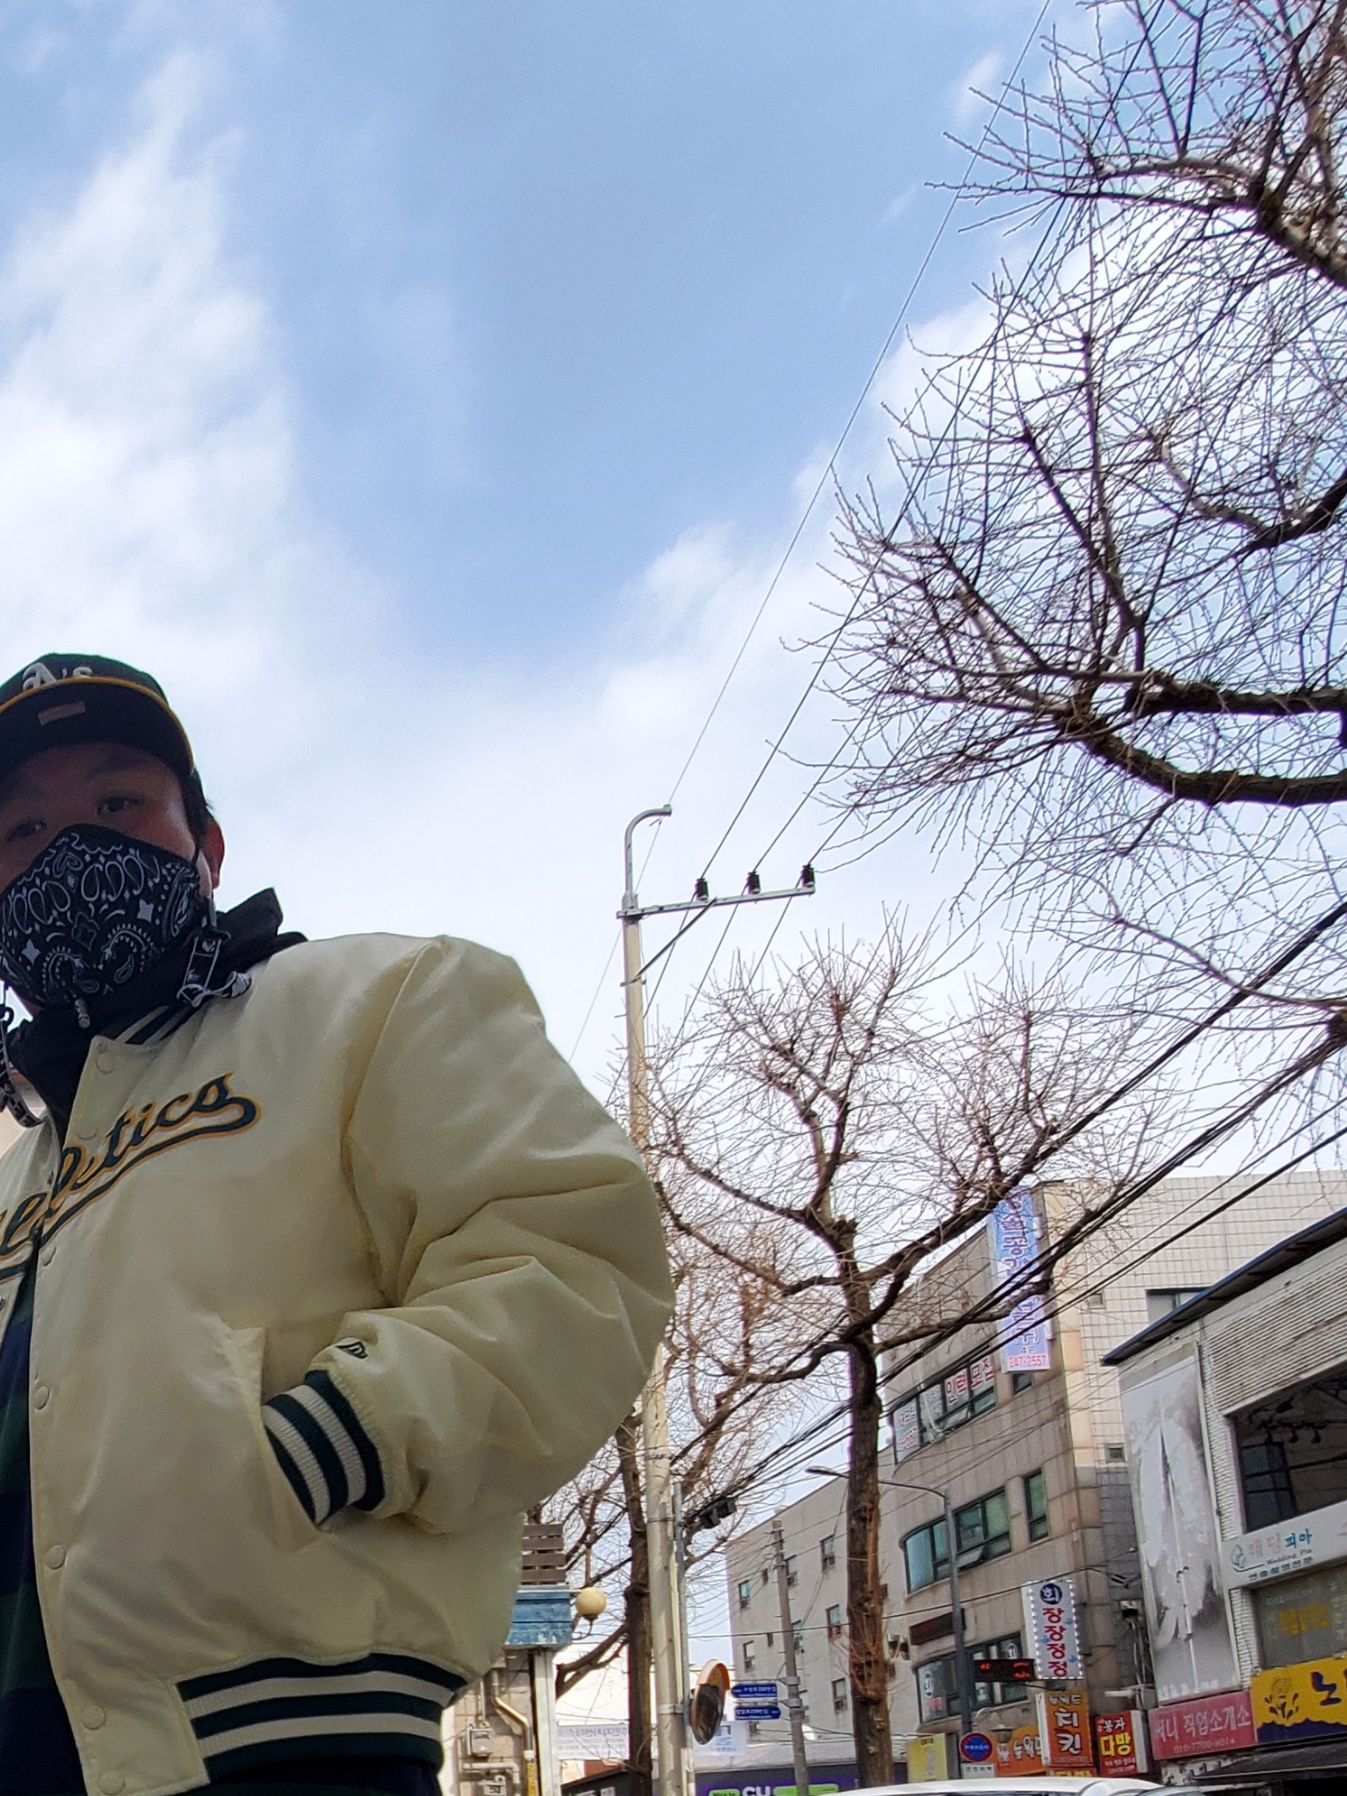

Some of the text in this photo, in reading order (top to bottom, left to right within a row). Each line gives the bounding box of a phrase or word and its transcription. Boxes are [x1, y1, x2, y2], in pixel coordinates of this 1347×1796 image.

[1041, 1584, 1063, 1605] 회
[1042, 1607, 1068, 1678] 장장정정
[1053, 1706, 1082, 1755] 치킨
[1183, 1703, 1251, 1739] 직업소개소
[1099, 1732, 1131, 1757] 다방
